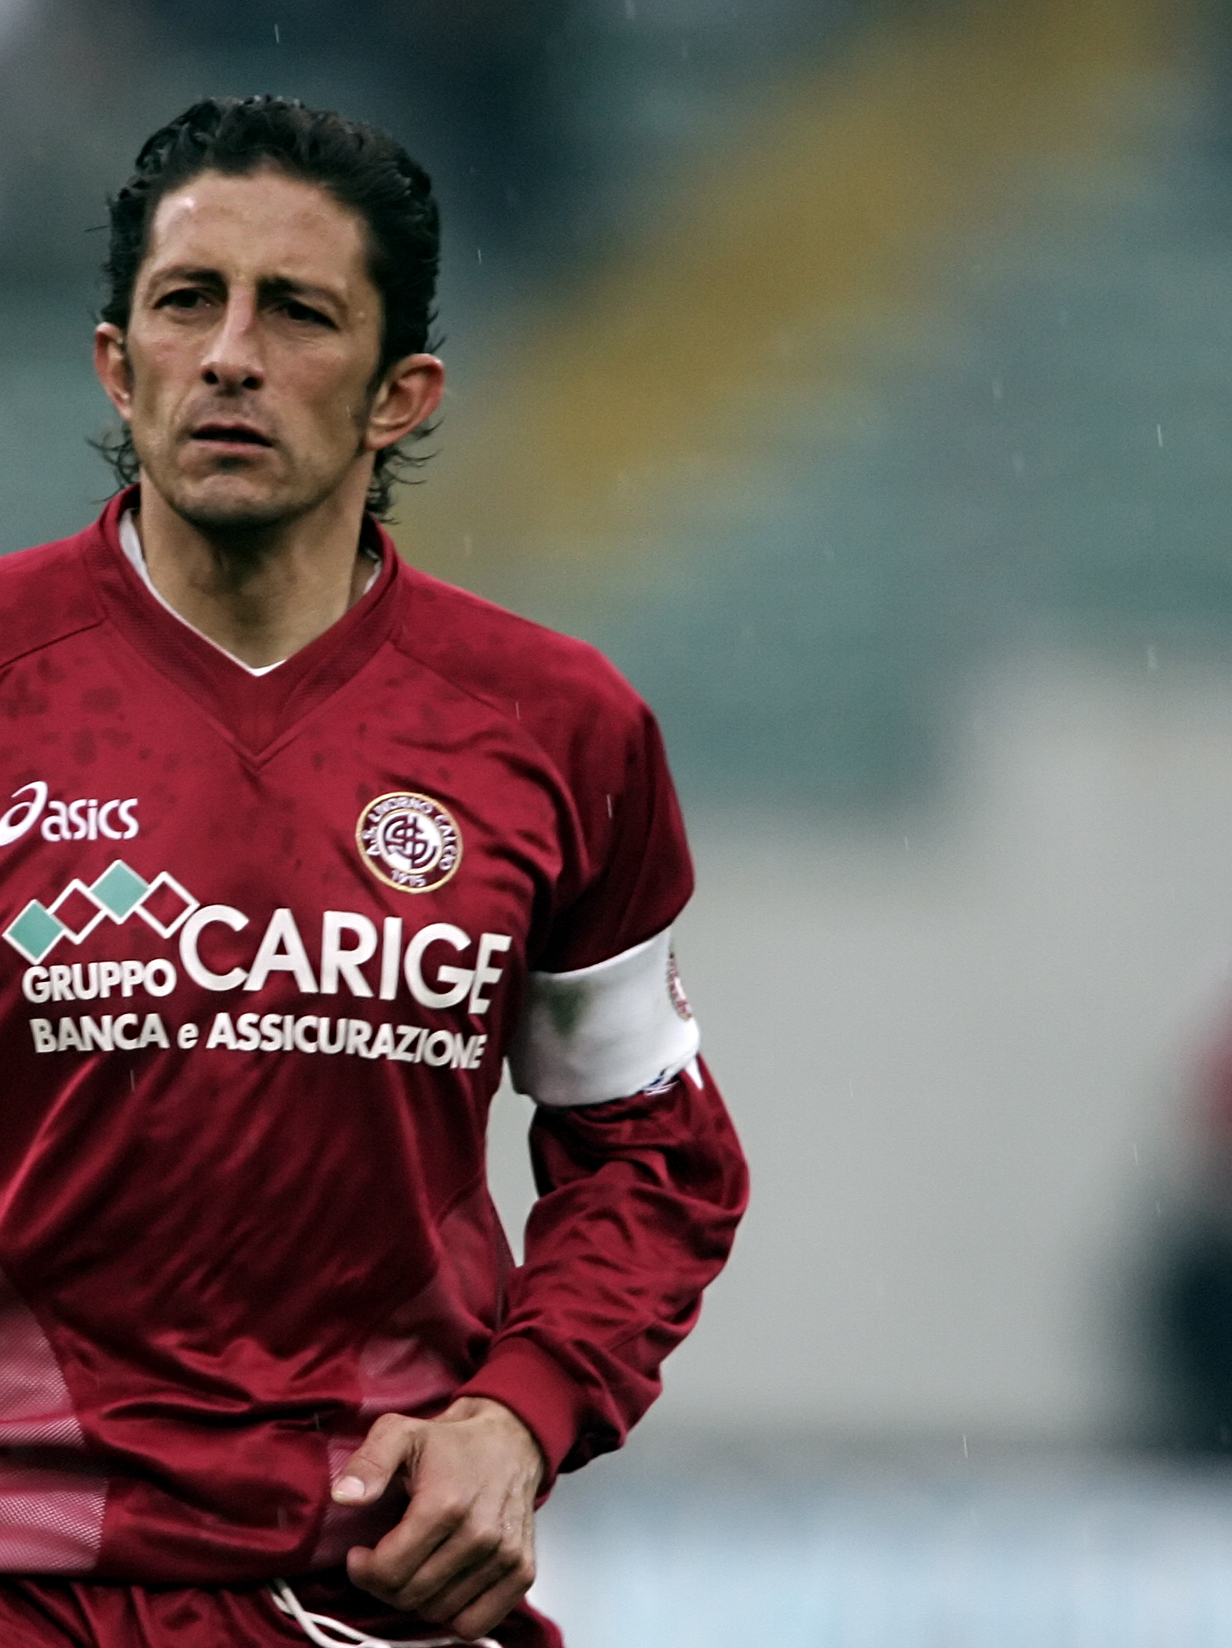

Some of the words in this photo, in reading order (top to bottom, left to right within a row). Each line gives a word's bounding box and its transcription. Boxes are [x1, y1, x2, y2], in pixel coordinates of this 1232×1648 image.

[41, 798, 139, 842] asics
[22, 958, 177, 1003] GRUPPO
[179, 904, 512, 1014] CARIGE
[29, 1013, 170, 1053] BANCA
[177, 1023, 199, 1049] e
[206, 1012, 486, 1070] ASSICURAZIONE
